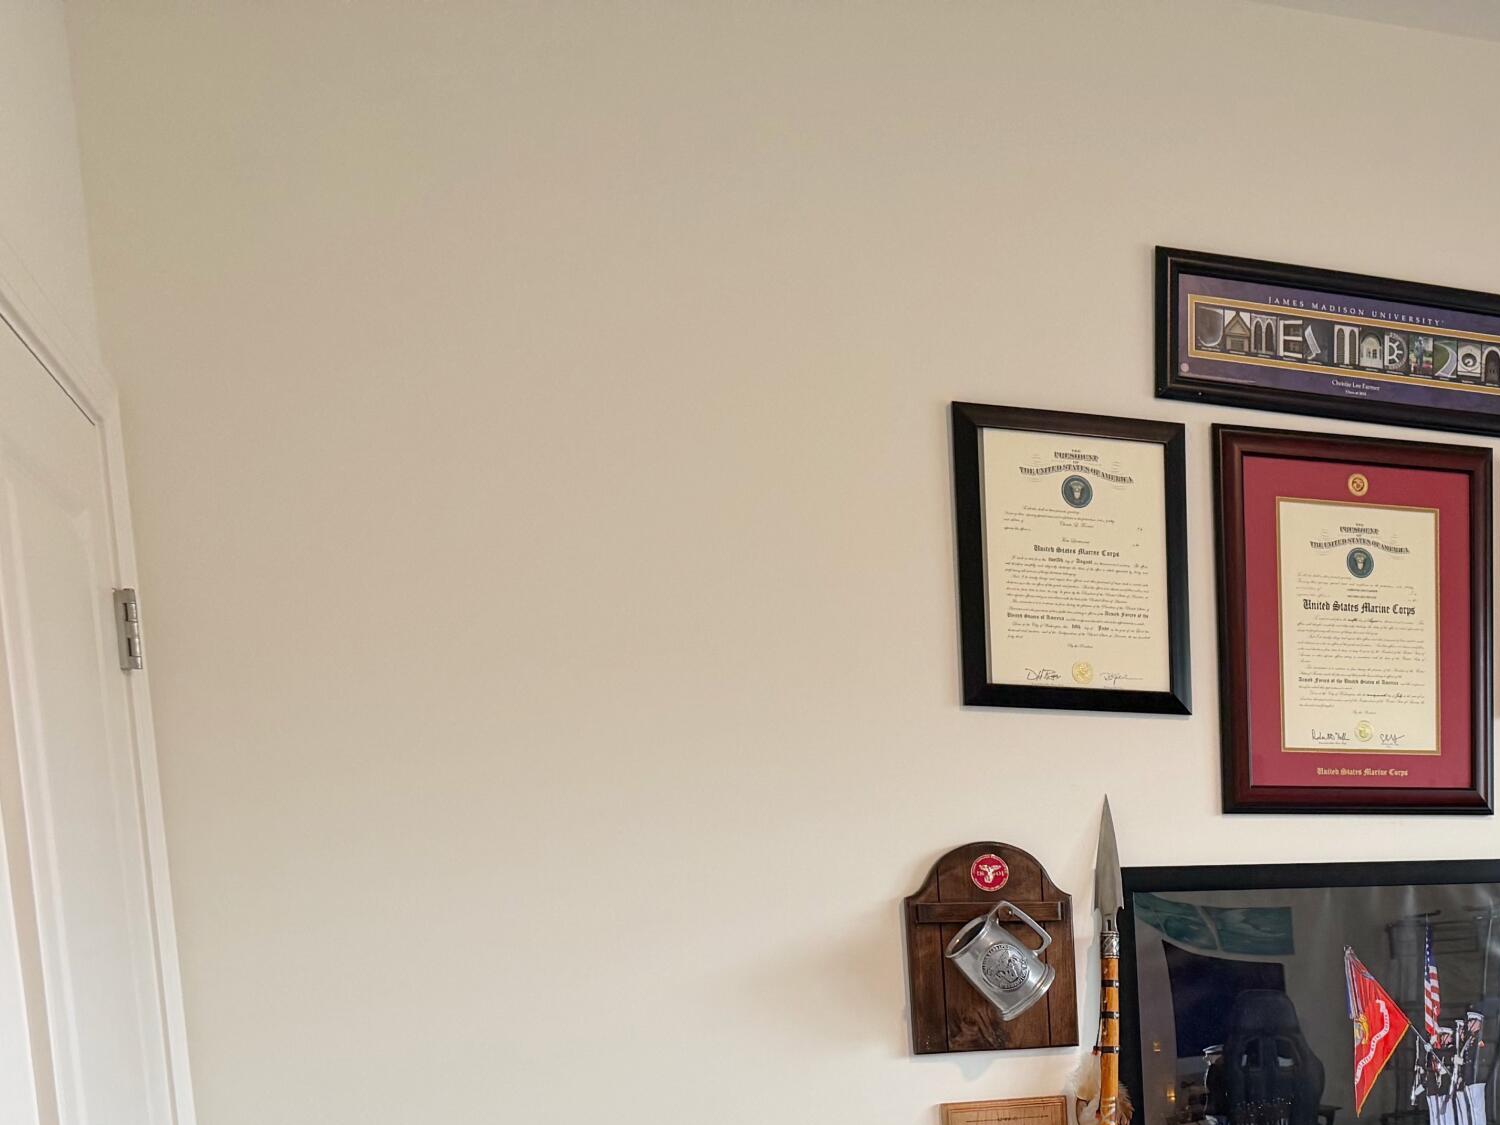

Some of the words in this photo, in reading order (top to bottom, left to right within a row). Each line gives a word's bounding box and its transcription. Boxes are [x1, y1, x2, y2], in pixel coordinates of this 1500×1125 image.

[1268, 296, 1304, 308] JAMES
[1311, 302, 1365, 316] MADISON
[1371, 310, 1442, 326] UNIVERSITY
[1054, 451, 1099, 462] PRESIDENT
[1033, 544, 1055, 553] United
[1055, 546, 1076, 555] States
[1078, 547, 1100, 556] Marine
[1101, 549, 1120, 558] Corps
[1303, 598, 1330, 611] United
[1332, 600, 1359, 613] States
[1361, 602, 1390, 614] Marine
[1392, 604, 1416, 616] Corps
[1316, 767, 1339, 776] United
[1340, 768, 1362, 776] States
[1363, 768, 1387, 777] Marine
[1388, 768, 1409, 777] Corps
